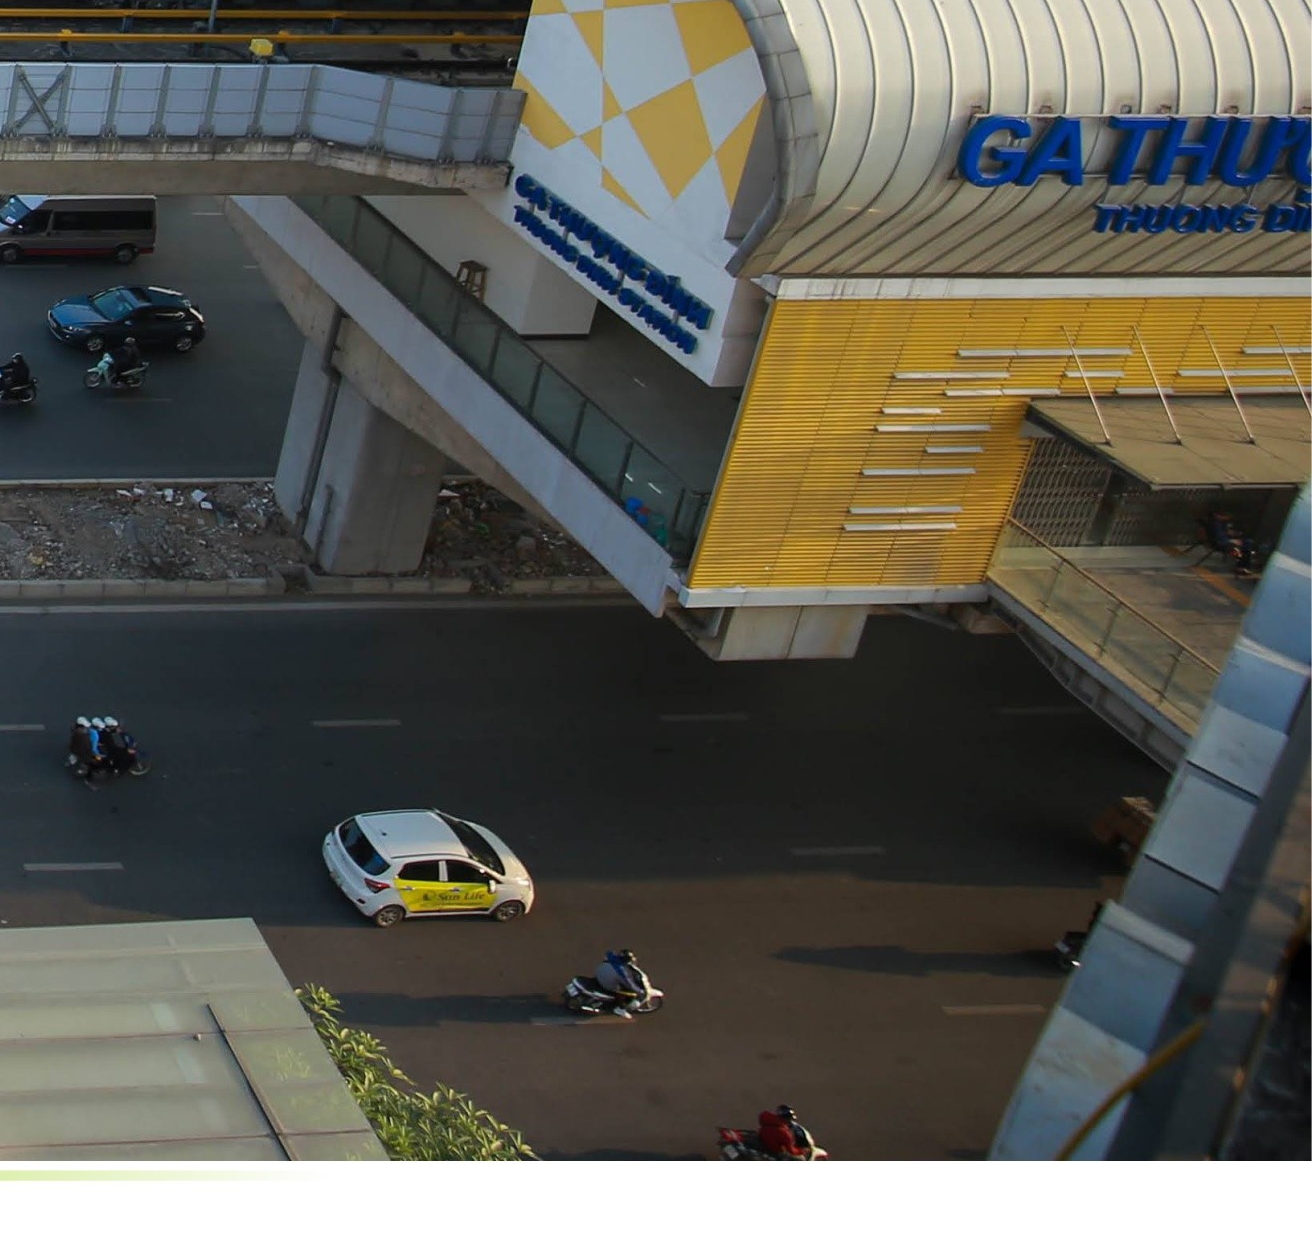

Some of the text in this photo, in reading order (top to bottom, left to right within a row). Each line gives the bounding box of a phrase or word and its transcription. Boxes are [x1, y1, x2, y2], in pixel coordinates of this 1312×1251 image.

[957, 114, 1084, 188] GA
[1093, 202, 1264, 234] THUONG
[463, 891, 485, 901] Life
